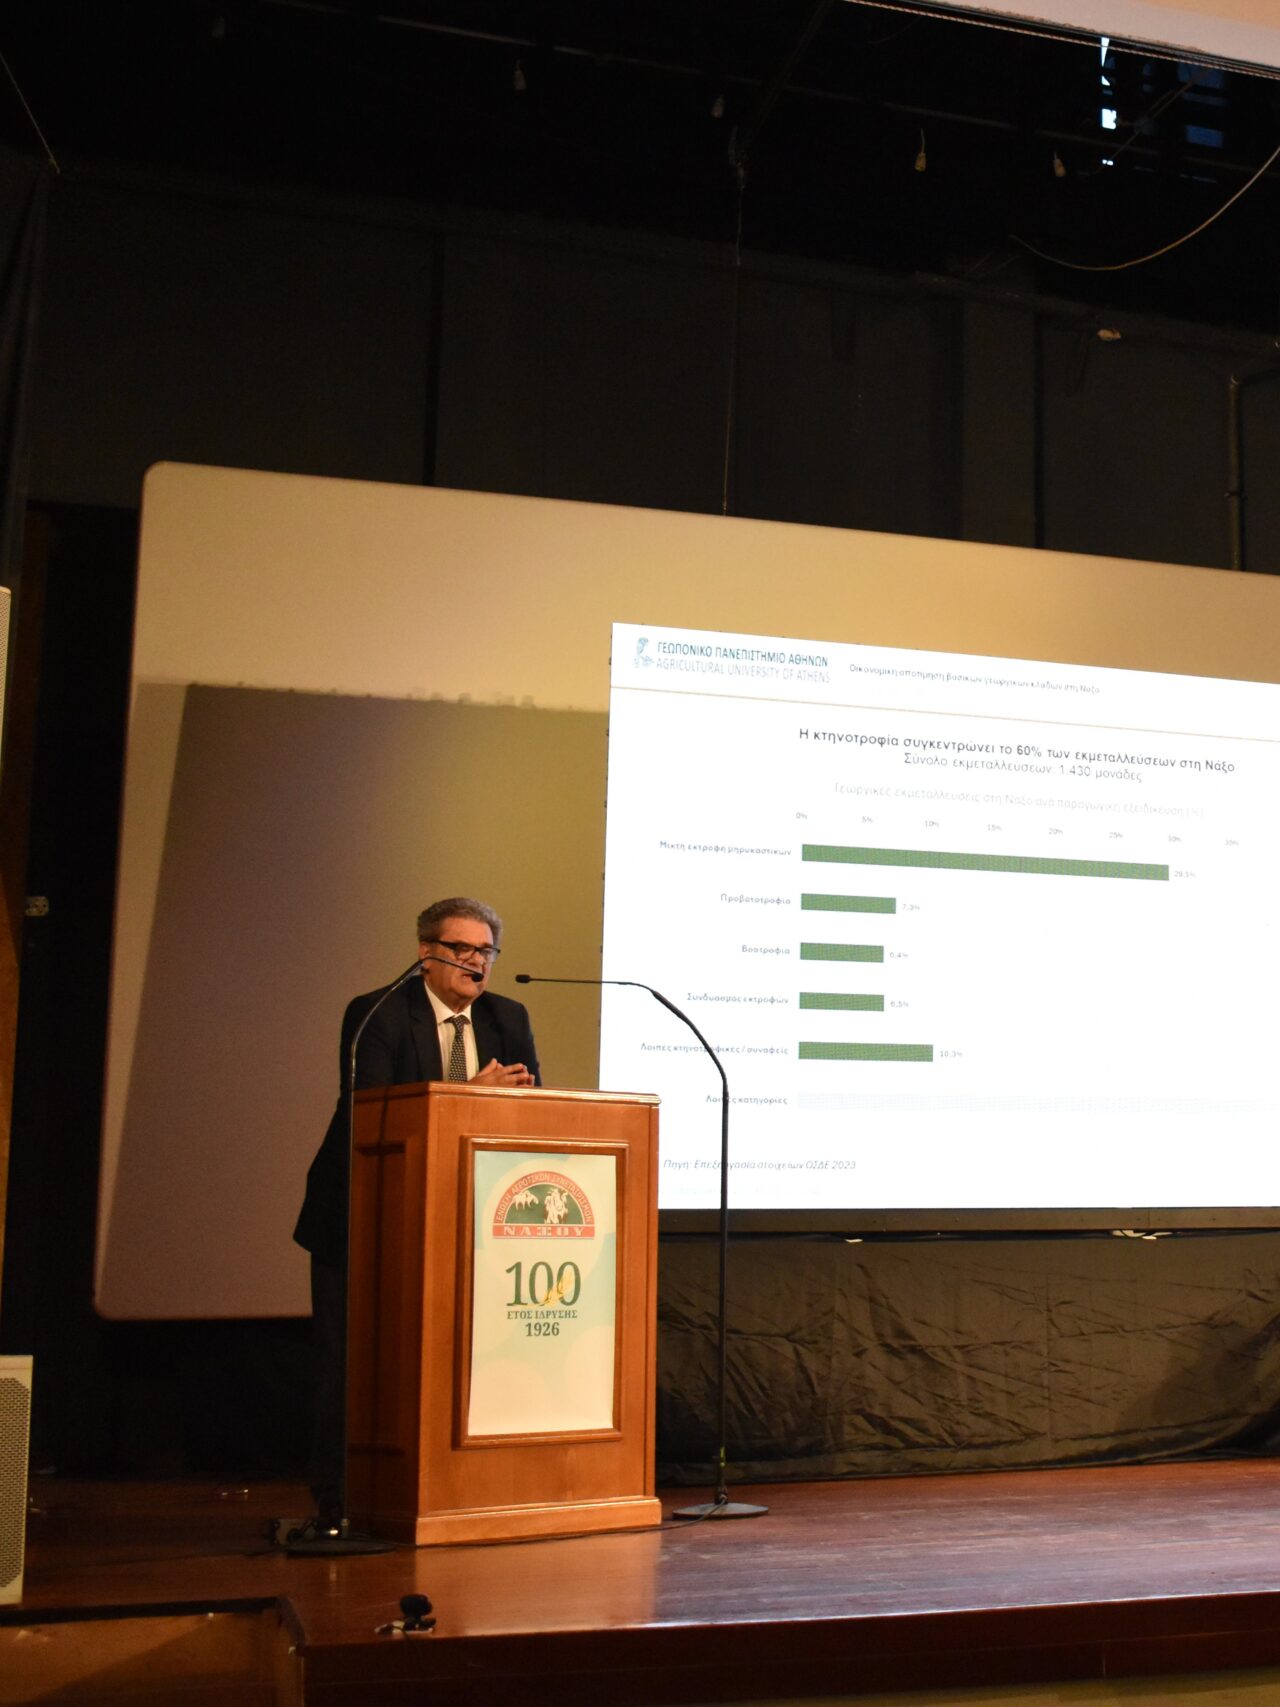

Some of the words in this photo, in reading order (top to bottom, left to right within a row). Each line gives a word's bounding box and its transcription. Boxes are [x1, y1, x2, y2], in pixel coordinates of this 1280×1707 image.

[657, 641, 713, 658] ΓΕΩΠΟΝΙΚΟ
[715, 647, 786, 664] ΠΑΝΕΠΙΣΤΗΜΙΟ
[788, 653, 828, 668] ΑΘΗΝΩΝ
[656, 658, 725, 676] AGRICULTURAL
[727, 664, 780, 680] UNIVERSITY
[782, 668, 795, 680] OF
[797, 670, 831, 684] ATHENS
[799, 728, 809, 740] Η
[813, 731, 899, 748] κτηνοτροφία
[903, 737, 995, 753] συγκεντρώνει
[999, 745, 1013, 755] το
[1016, 745, 1042, 758] 60%
[1047, 749, 1070, 760] των
[1075, 750, 1177, 768] εκμεταλλεύσεων
[1180, 759, 1202, 772] στη
[1206, 760, 1236, 775] Νάξο
[904, 752, 948, 767] Σύνολο
[1060, 765, 1091, 778] 1.430
[1096, 770, 1143, 784] μονάδες
[706, 1095, 737, 1104] Λοις
[805, 1160, 831, 1170] ΟΣΔΕ
[832, 1160, 856, 1170] 2023
[503, 1226, 585, 1236] ΝΑΞΟΥ
[505, 1261, 582, 1307] 100
[507, 1310, 533, 1320] ΕΤΟΣ
[535, 1310, 578, 1319] ΙΔΡΥΣΗΣ
[525, 1322, 560, 1337] 1926
